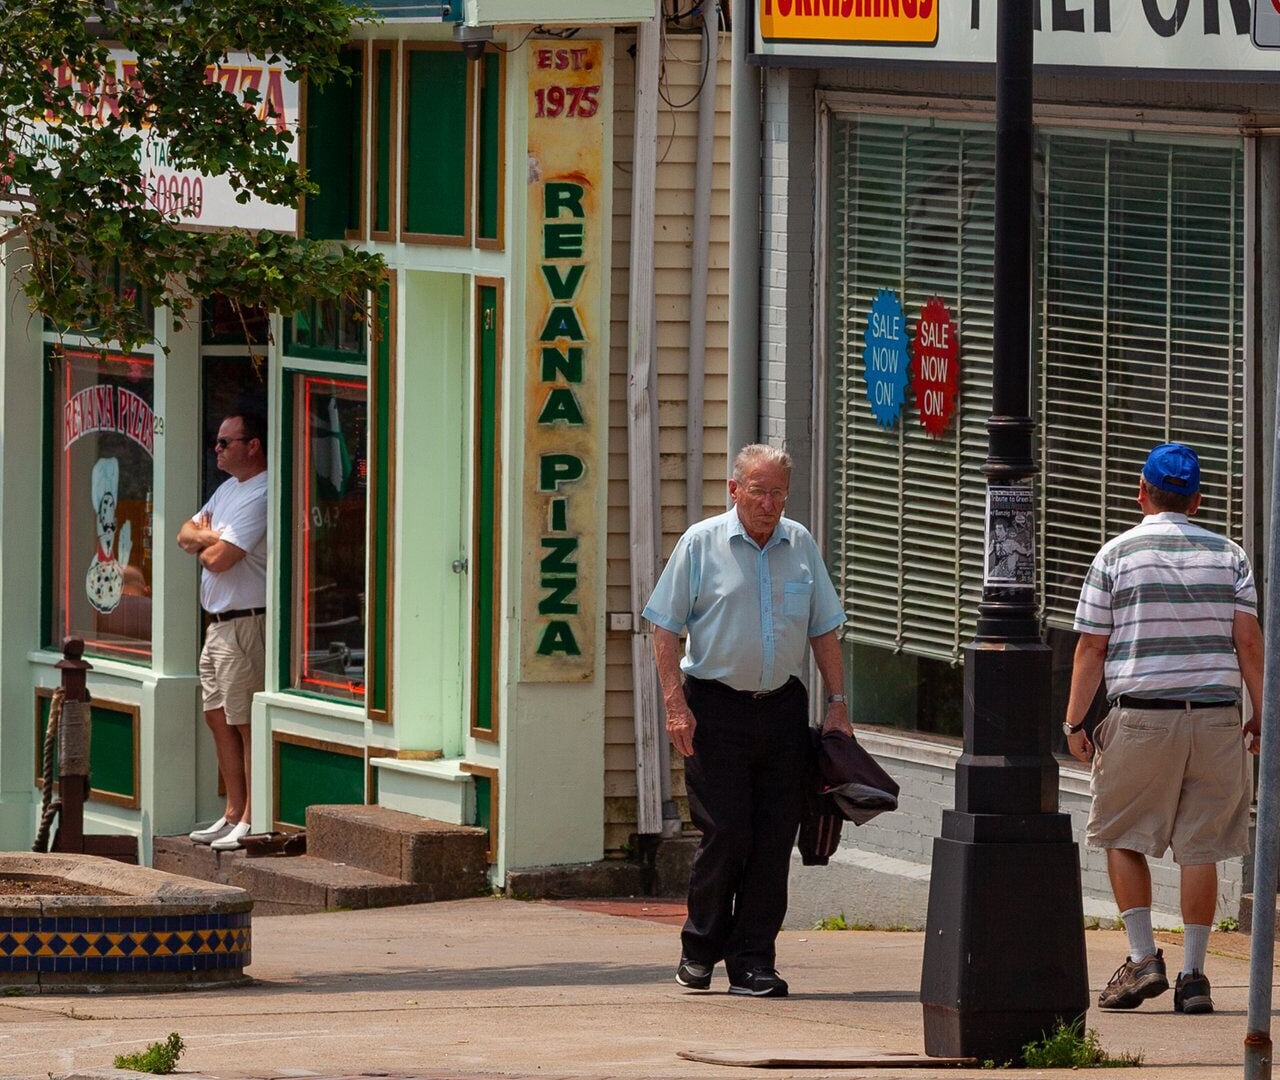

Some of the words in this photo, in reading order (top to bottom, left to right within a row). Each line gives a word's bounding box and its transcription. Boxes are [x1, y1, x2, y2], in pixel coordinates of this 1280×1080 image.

[536, 48, 593, 72] EST.
[534, 85, 600, 119] 1975
[538, 182, 587, 425] REVANA
[872, 312, 900, 341] SALE
[921, 320, 949, 349] SALE
[872, 346, 899, 375] NOW
[921, 355, 948, 383] NOW
[875, 380, 894, 407] ON!
[923, 389, 944, 417] ON!
[64, 384, 116, 452] REVANA
[538, 452, 586, 658] PIZZA
